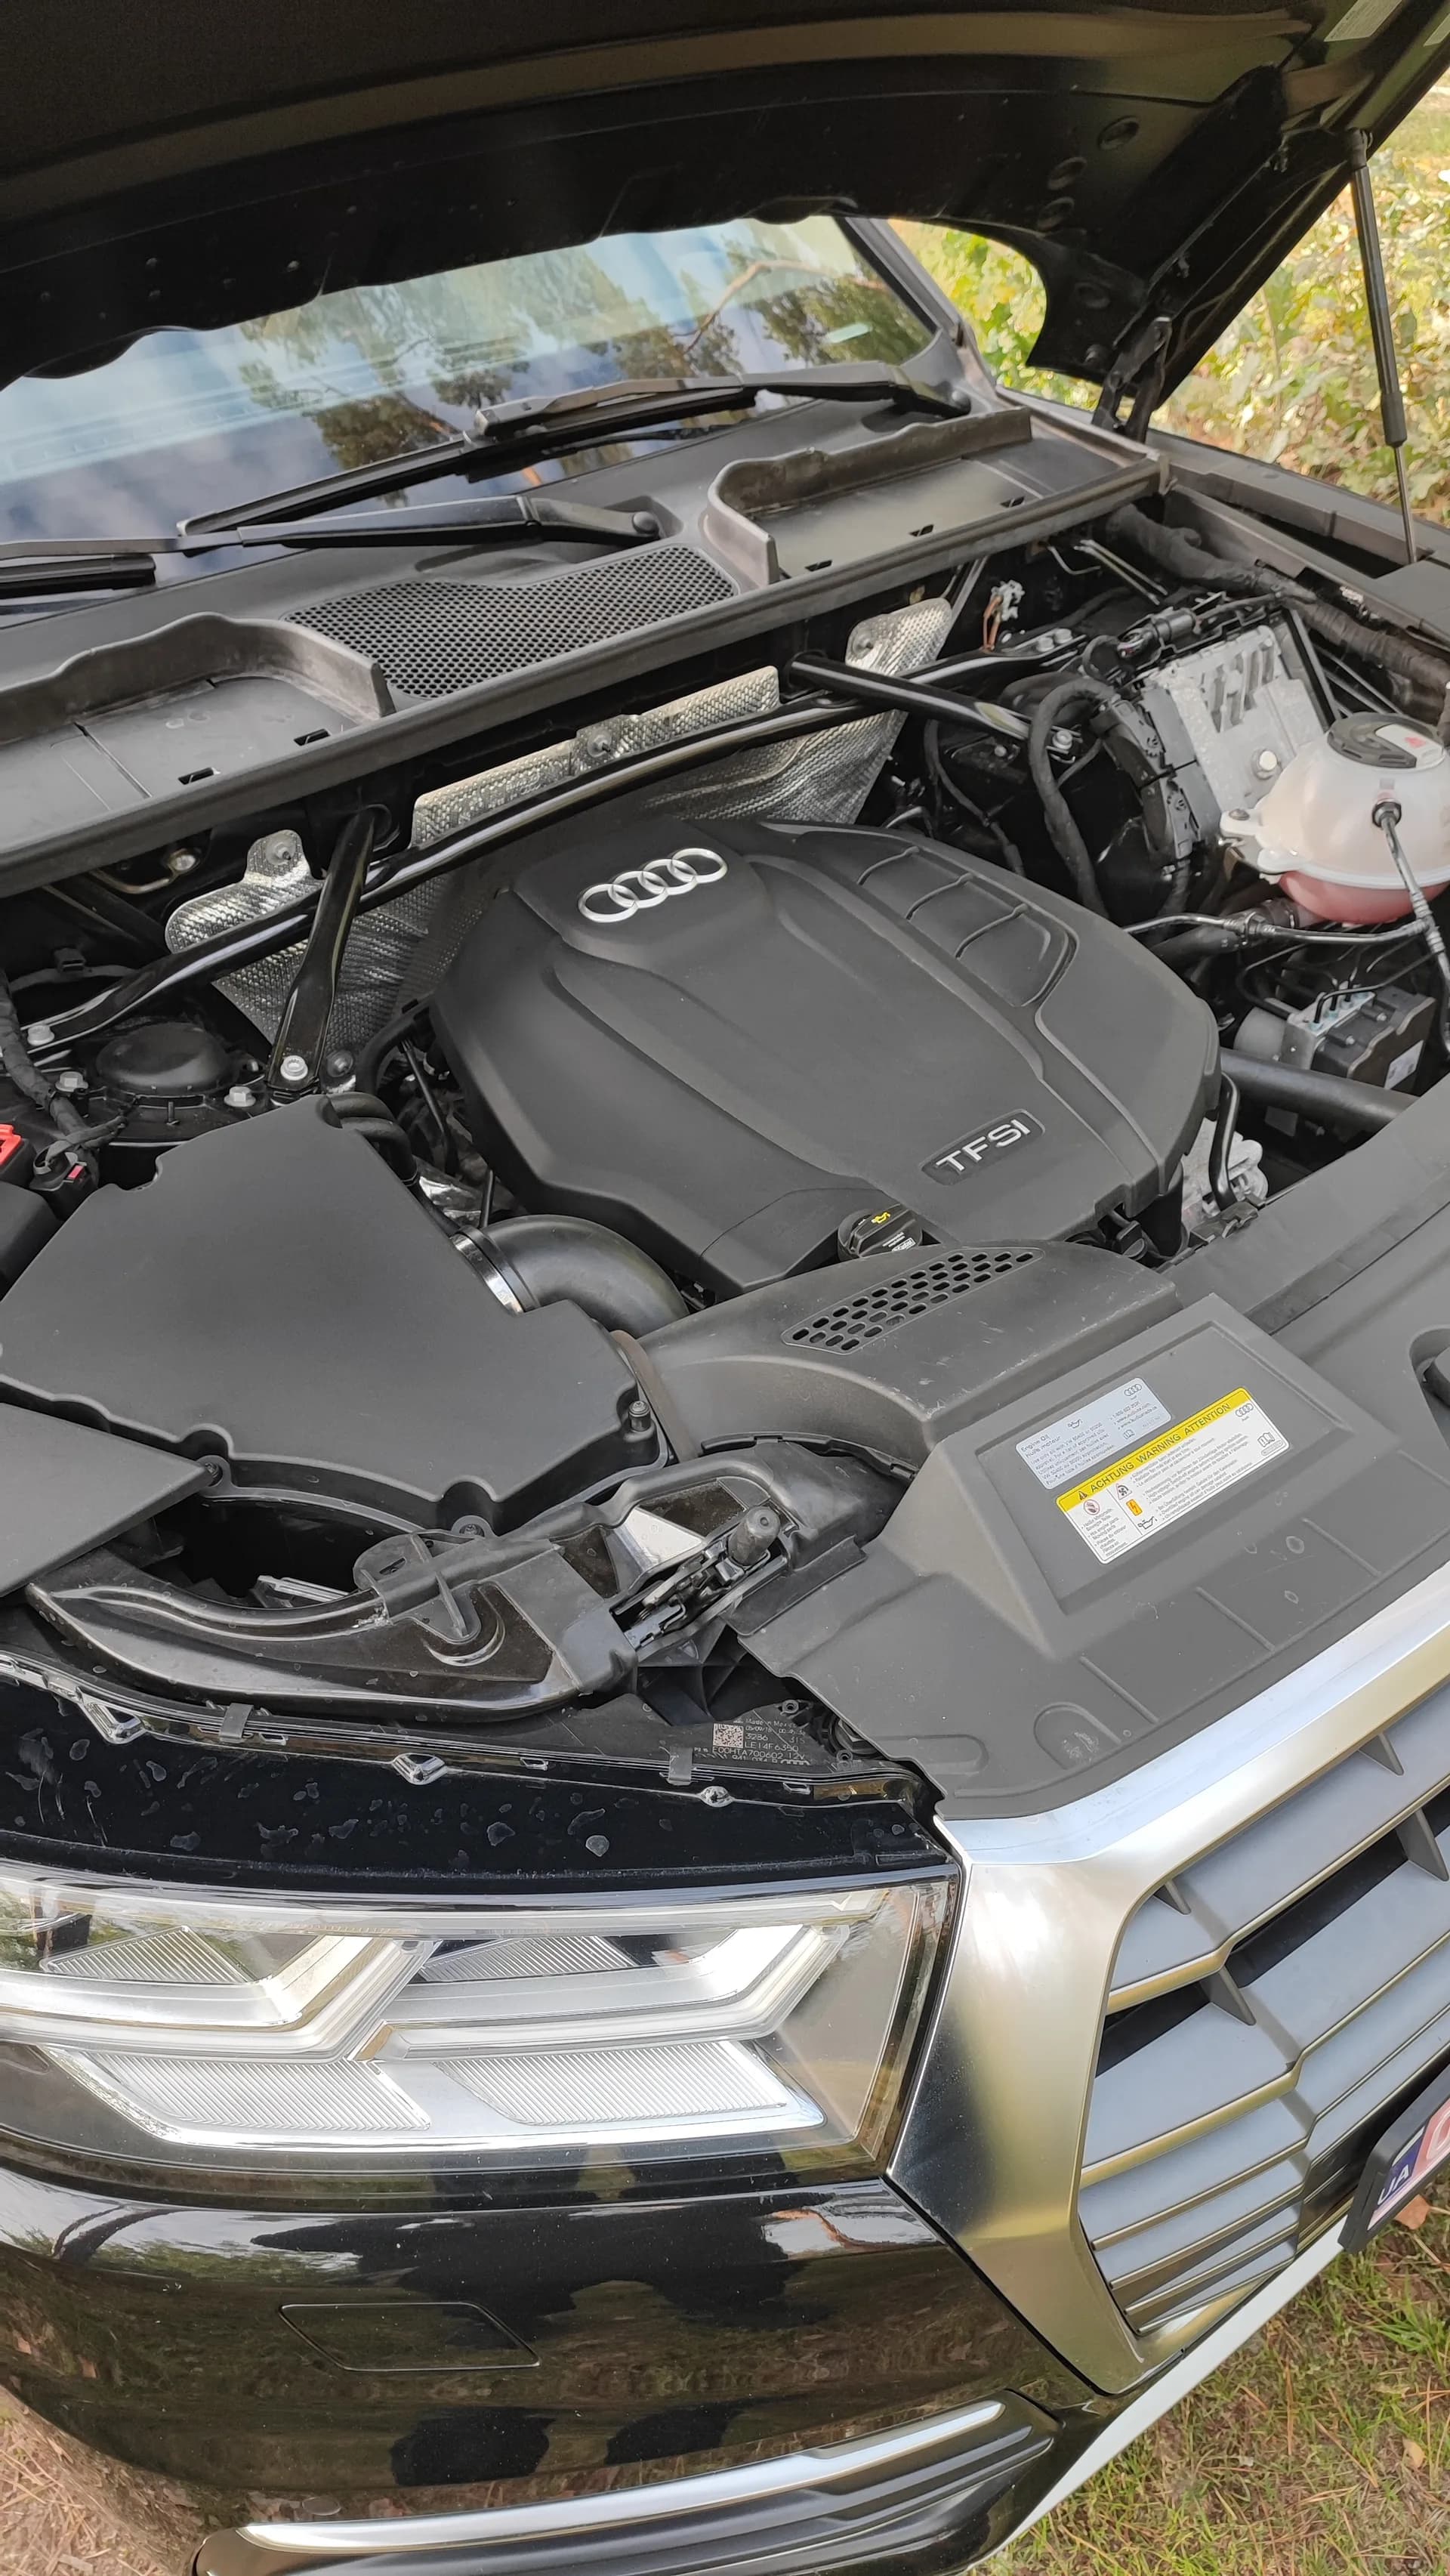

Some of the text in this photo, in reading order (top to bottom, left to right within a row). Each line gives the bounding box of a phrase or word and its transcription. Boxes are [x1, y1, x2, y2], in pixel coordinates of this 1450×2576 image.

[936, 1119, 1031, 1172] TFSI
[1090, 1462, 1134, 1493] ACHTUNG
[1135, 1433, 1181, 1463] WARNING
[1183, 1403, 1231, 1435] ATTENTION
[745, 1732, 769, 1741] 3286
[1378, 2164, 1410, 2206] UA
